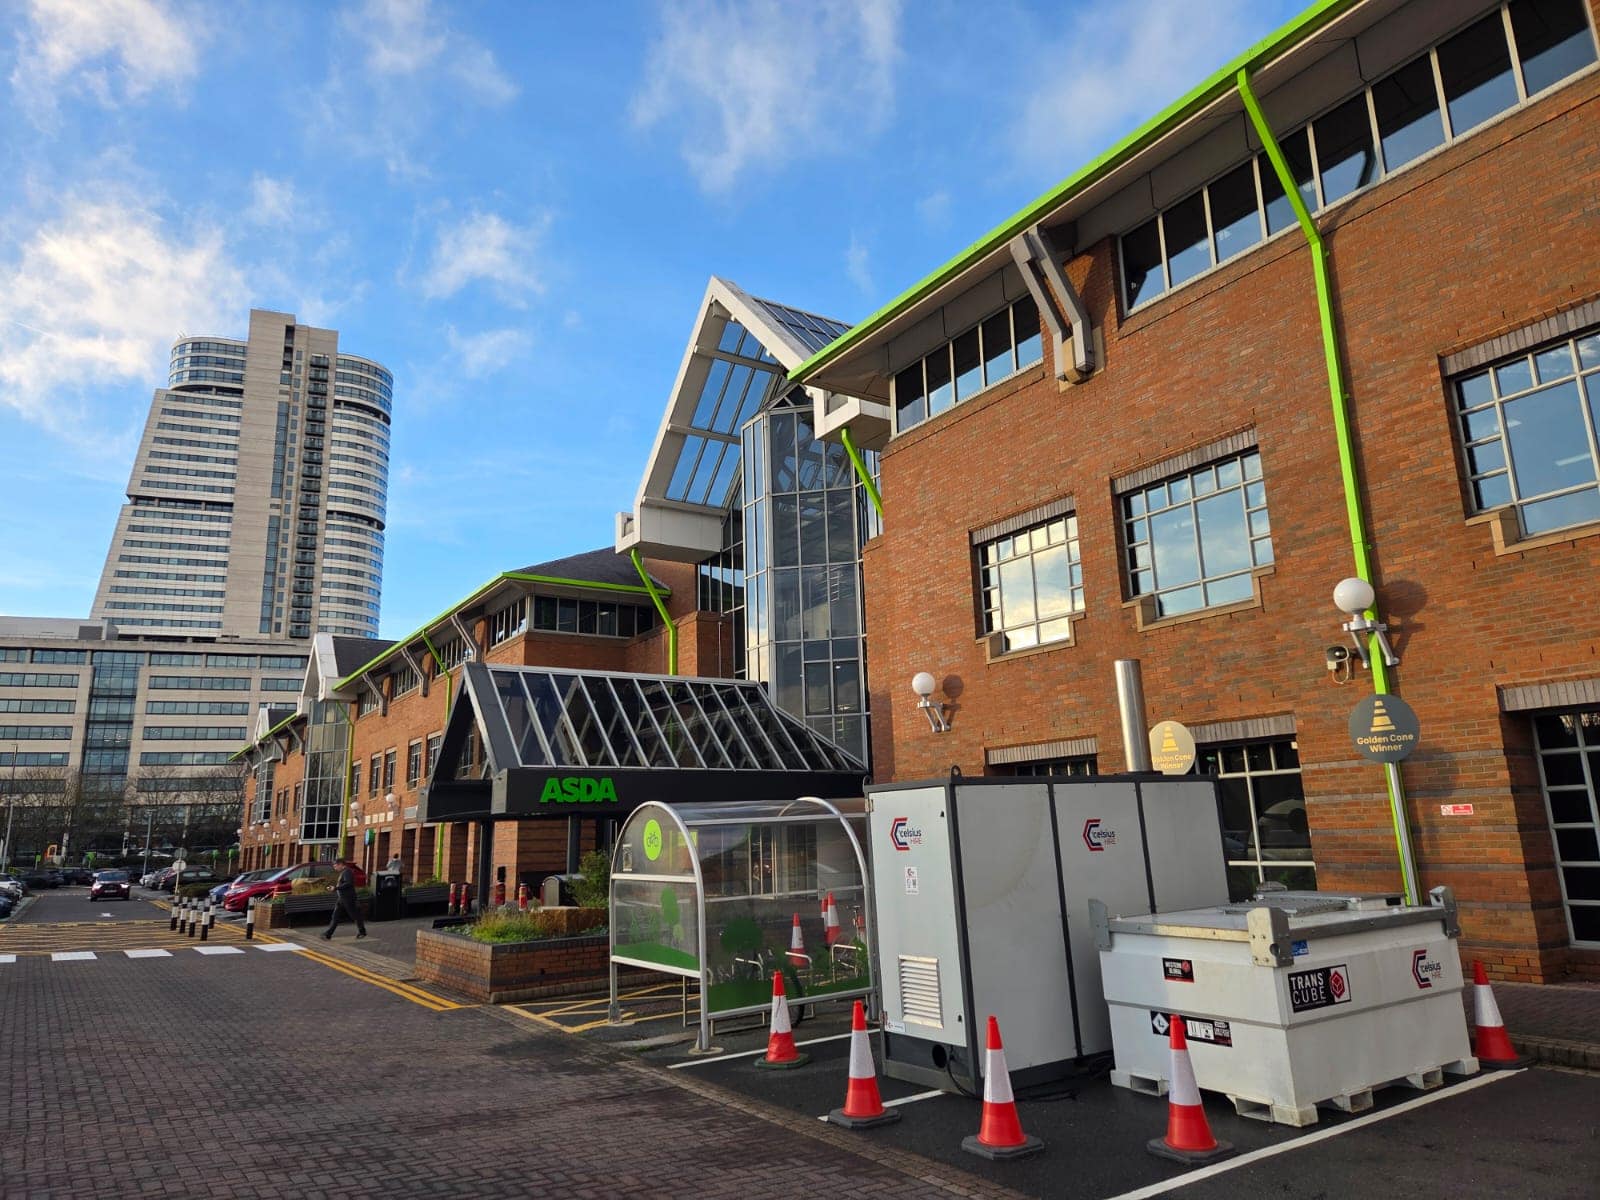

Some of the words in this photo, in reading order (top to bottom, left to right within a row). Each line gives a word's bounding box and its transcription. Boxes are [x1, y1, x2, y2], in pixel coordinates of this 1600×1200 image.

[1357, 735, 1389, 745] Golden
[1390, 734, 1414, 742] Cone
[1369, 744, 1403, 753] Winner
[540, 777, 618, 803] ASDA
[899, 828, 922, 838] celsius
[1290, 972, 1324, 990] TRANS
[1293, 987, 1327, 1004] CUBE
